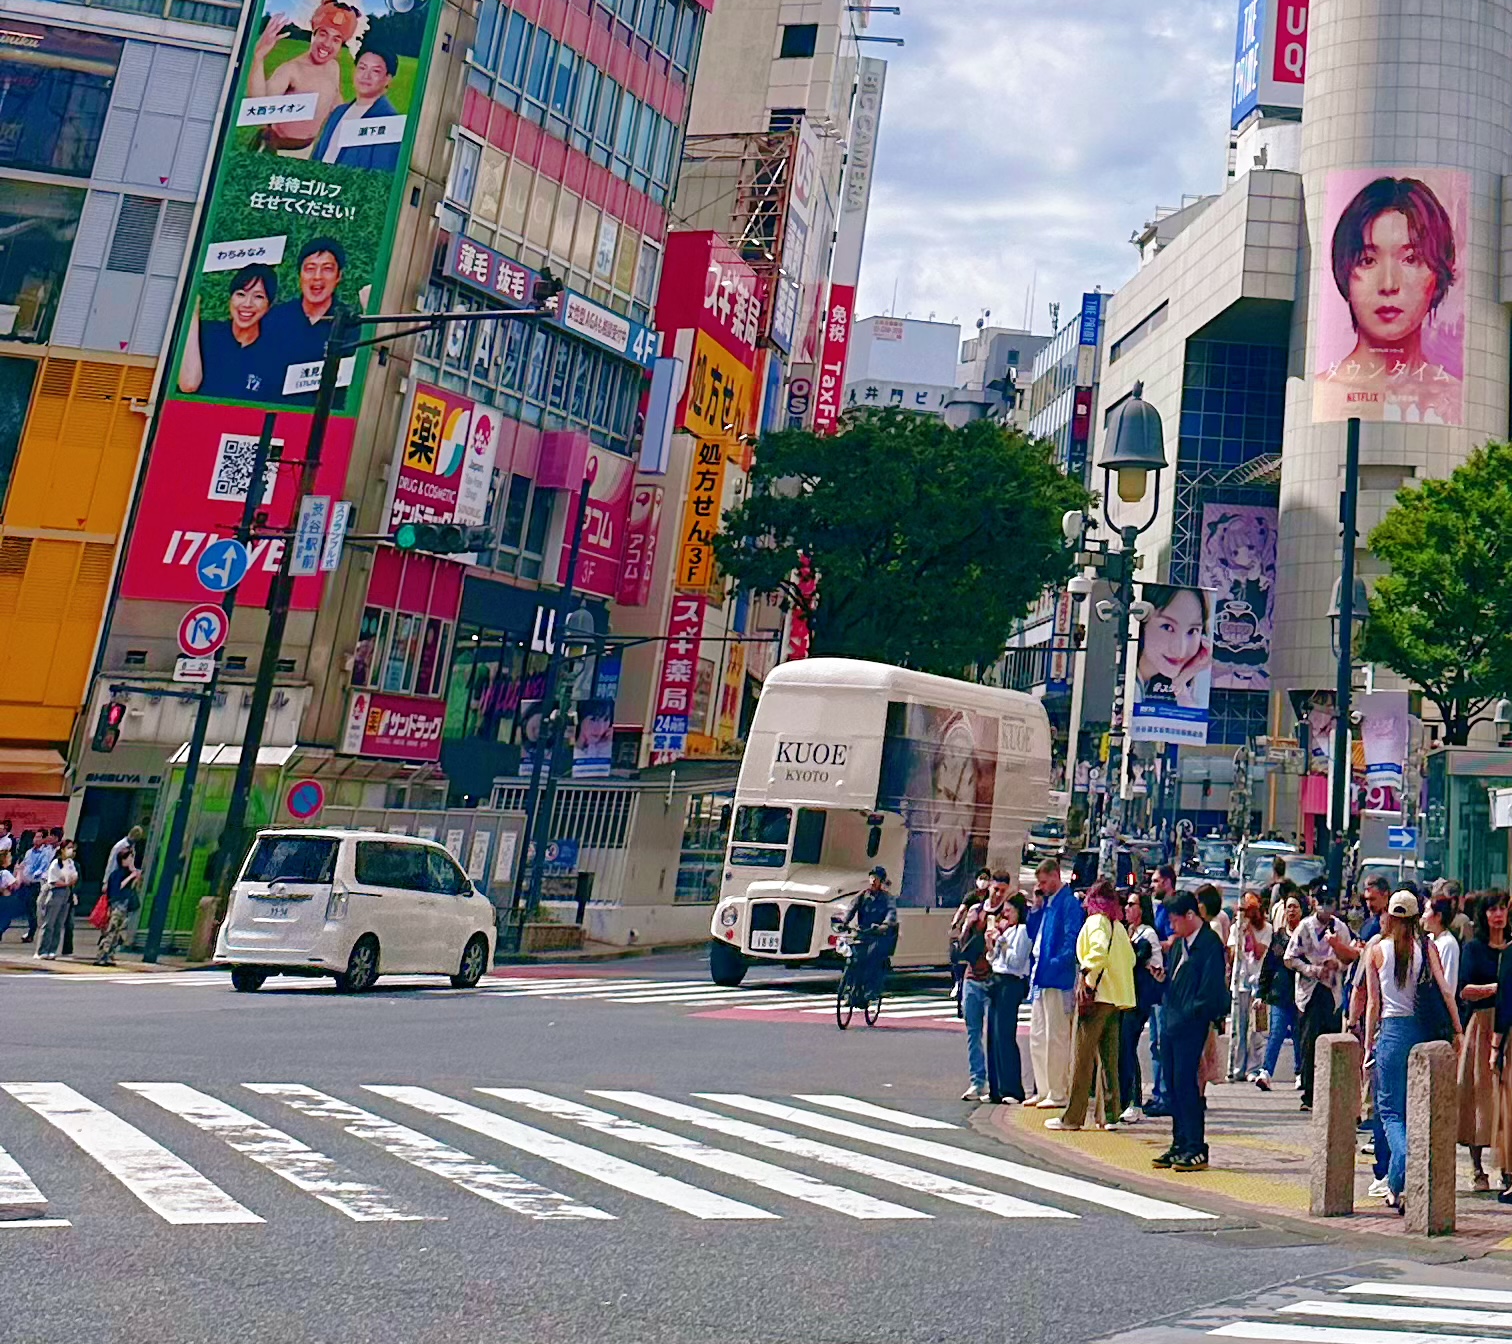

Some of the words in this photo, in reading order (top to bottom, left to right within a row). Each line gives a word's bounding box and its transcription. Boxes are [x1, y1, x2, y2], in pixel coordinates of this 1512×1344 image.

[858, 72, 880, 110] BIC
[246, 103, 306, 116] 大西ライオン
[846, 115, 876, 213] CAMERA
[268, 173, 342, 198] 接待ゴルフ
[217, 247, 267, 260] わちみなみ
[494, 261, 526, 301] 抜毛
[703, 258, 761, 352] スギ薬局
[828, 304, 848, 343] 免税
[632, 327, 656, 364] 4F
[1325, 359, 1450, 382] ダウンタイム
[1346, 392, 1379, 403] NETFLIX
[408, 402, 441, 464] 薬
[398, 475, 418, 493] DRUG
[688, 442, 722, 544] 処方せん
[301, 502, 325, 570] 渋谷駅前
[581, 561, 596, 585] 3F
[624, 533, 645, 580] アコム
[687, 547, 702, 582] 3F
[660, 600, 699, 712] スギ薬局
[389, 712, 442, 740] サンドラッグ
[1001, 721, 1034, 752] KUOE
[776, 741, 847, 766] KUOE
[785, 768, 829, 783] KYOTO
